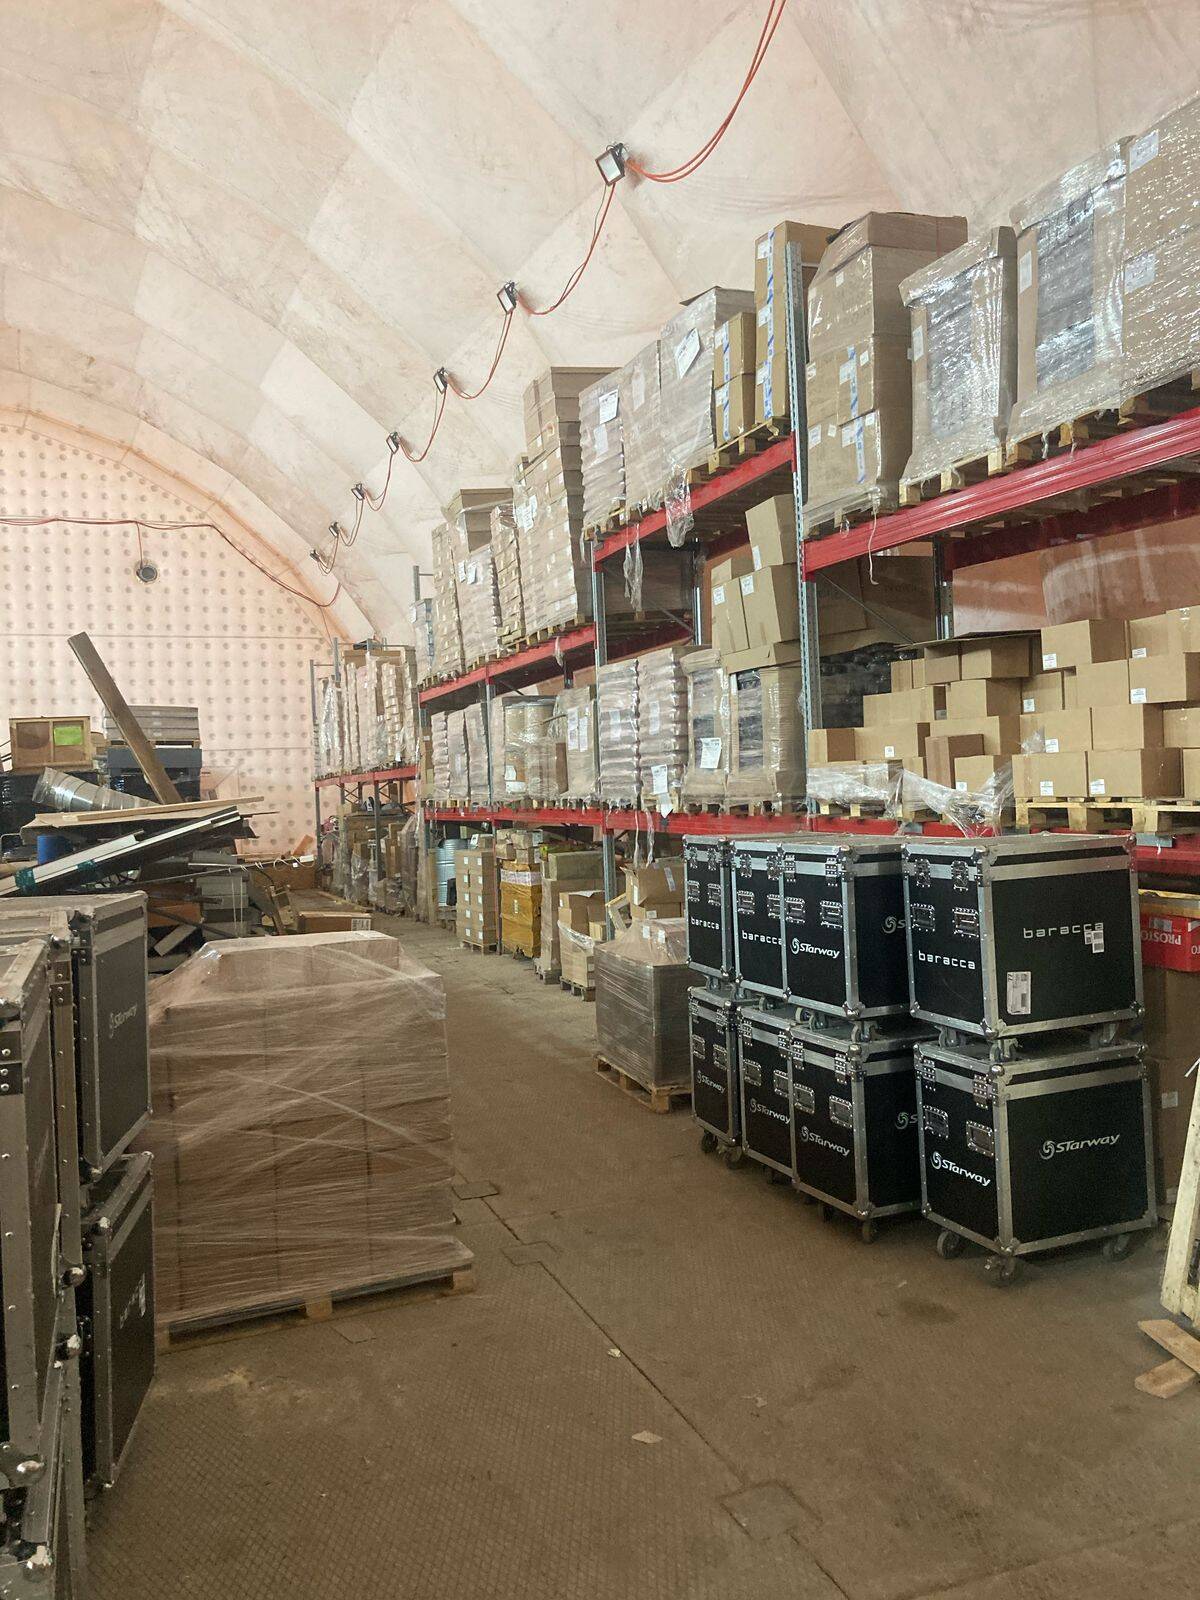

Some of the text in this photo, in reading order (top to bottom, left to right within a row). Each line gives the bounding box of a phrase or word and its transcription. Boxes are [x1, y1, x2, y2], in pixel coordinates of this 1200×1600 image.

[691, 916, 720, 930] baracca
[1022, 922, 1104, 939] baracca
[918, 950, 976, 970] baracca
